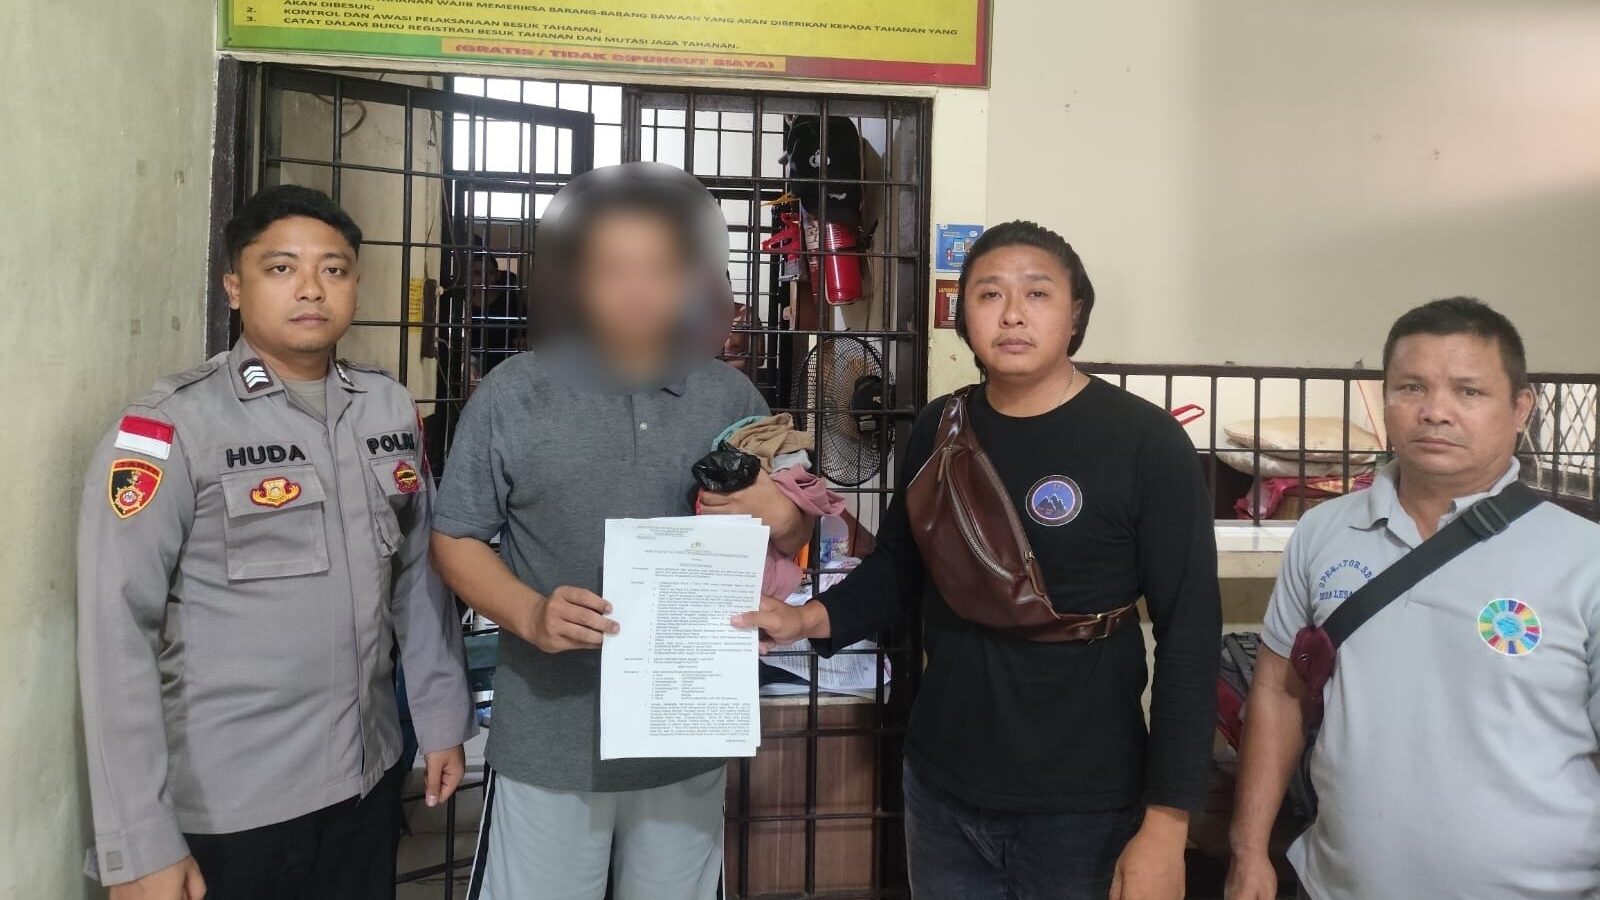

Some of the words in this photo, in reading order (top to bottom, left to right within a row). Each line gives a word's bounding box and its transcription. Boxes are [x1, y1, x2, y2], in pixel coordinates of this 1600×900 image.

[284, 9, 339, 17] KONTROL
[416, 16, 500, 26] PELAKSANAAN
[543, 24, 602, 33] TAHANAN;
[476, 3, 546, 12] MEMERIKSA
[550, 7, 648, 19] BARANG-BARANG
[651, 14, 700, 22] BAWAAN
[770, 20, 827, 28] DIBERIKAN
[830, 23, 872, 31] KEPADA
[875, 25, 926, 34] TAHANAN
[284, 17, 322, 25] CATAT
[325, 20, 369, 28] DALAM
[372, 22, 405, 30] BUKU
[409, 25, 475, 34] REGISTRASI
[517, 31, 574, 40] TAHANAN
[605, 37, 648, 45] MUTASI
[682, 41, 739, 49] TAHANAN.
[549, 49, 609, 61] TIDAK
[612, 53, 709, 66] DIPUNGUT
[366, 432, 415, 455] POLRI
[225, 444, 306, 468] HUDA
